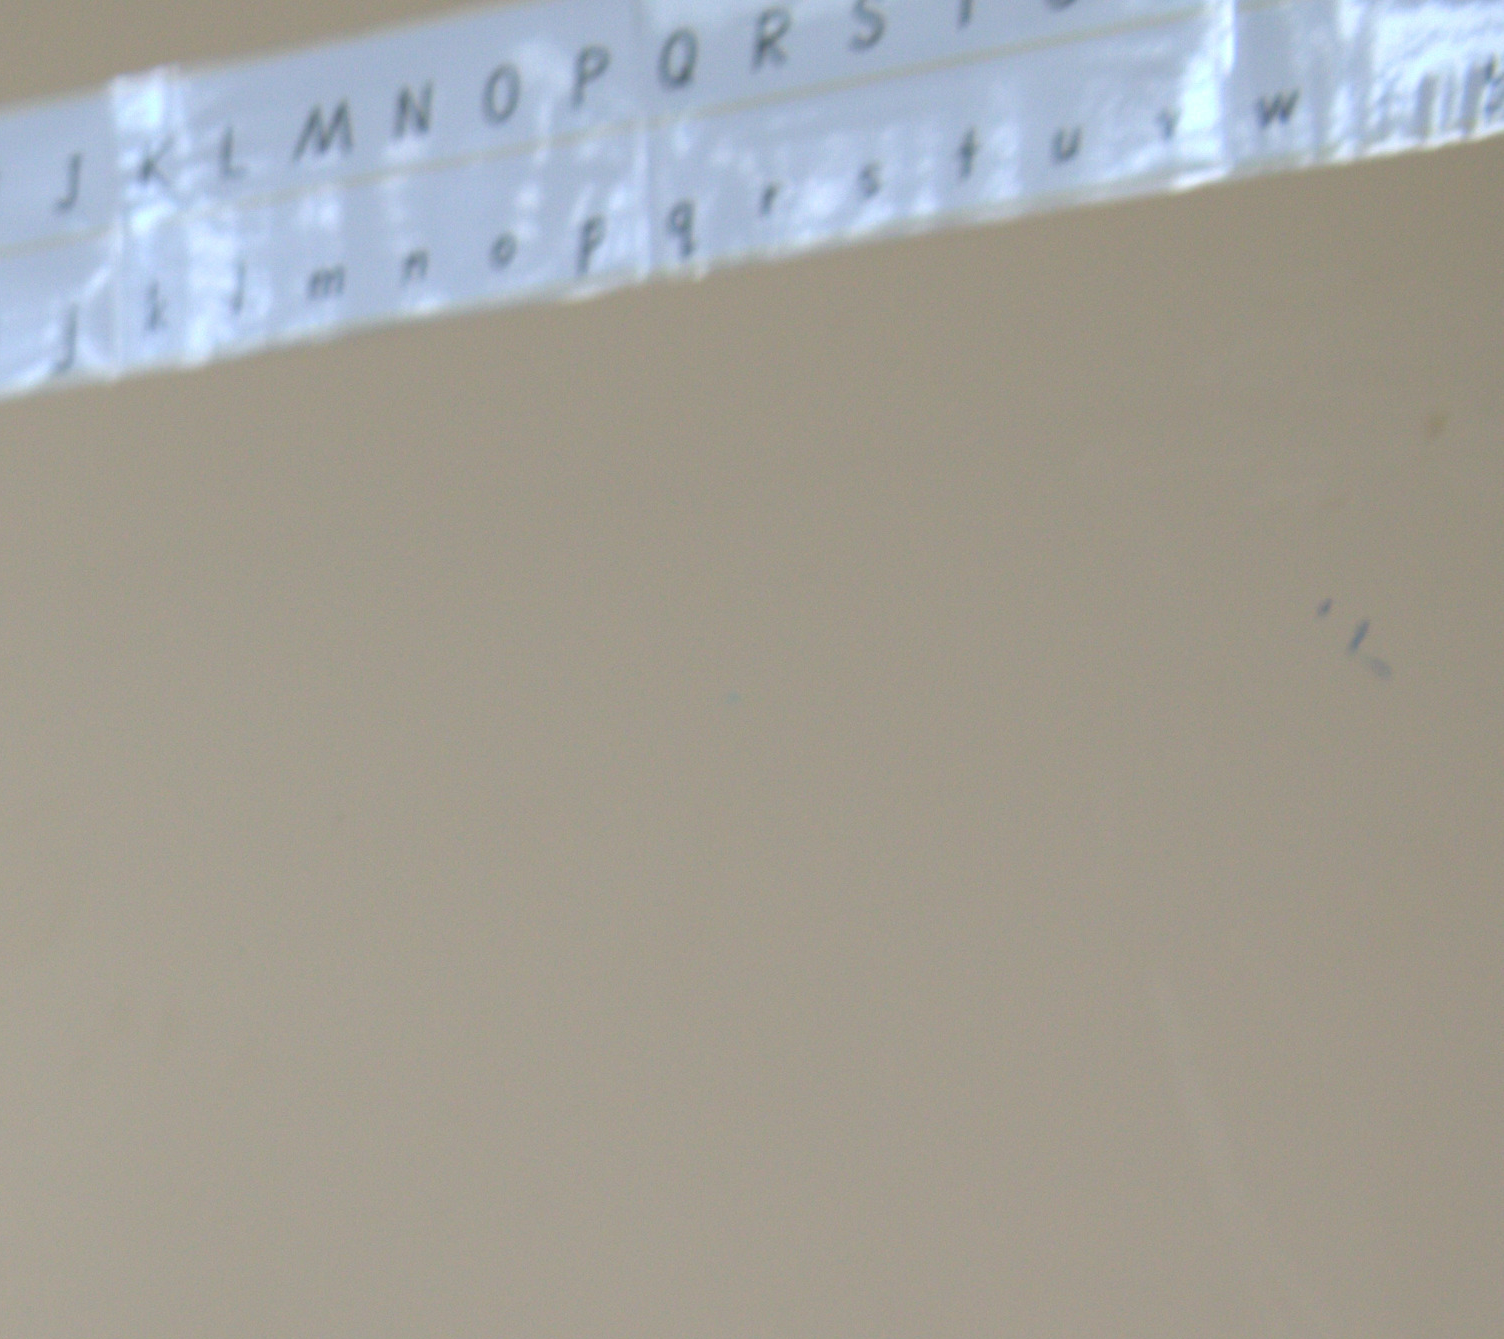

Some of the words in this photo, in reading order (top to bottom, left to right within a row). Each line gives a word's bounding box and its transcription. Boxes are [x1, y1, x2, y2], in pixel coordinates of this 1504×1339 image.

[56, 154, 82, 212] J
[135, 136, 172, 186] K
[217, 124, 247, 181] L
[291, 97, 355, 164] M
[393, 80, 434, 140] N
[480, 63, 520, 125] O
[570, 46, 609, 109] P
[657, 28, 699, 92] Q
[750, 6, 791, 74] R
[849, 0, 886, 52] S
[146, 279, 168, 334] k
[308, 263, 345, 300] m
[401, 248, 428, 286] n
[490, 229, 516, 269] o
[575, 212, 604, 275] p
[666, 199, 696, 257] q
[760, 181, 781, 216] r
[856, 160, 882, 200] s
[1052, 125, 1083, 164] u
[1255, 86, 1301, 132] w
